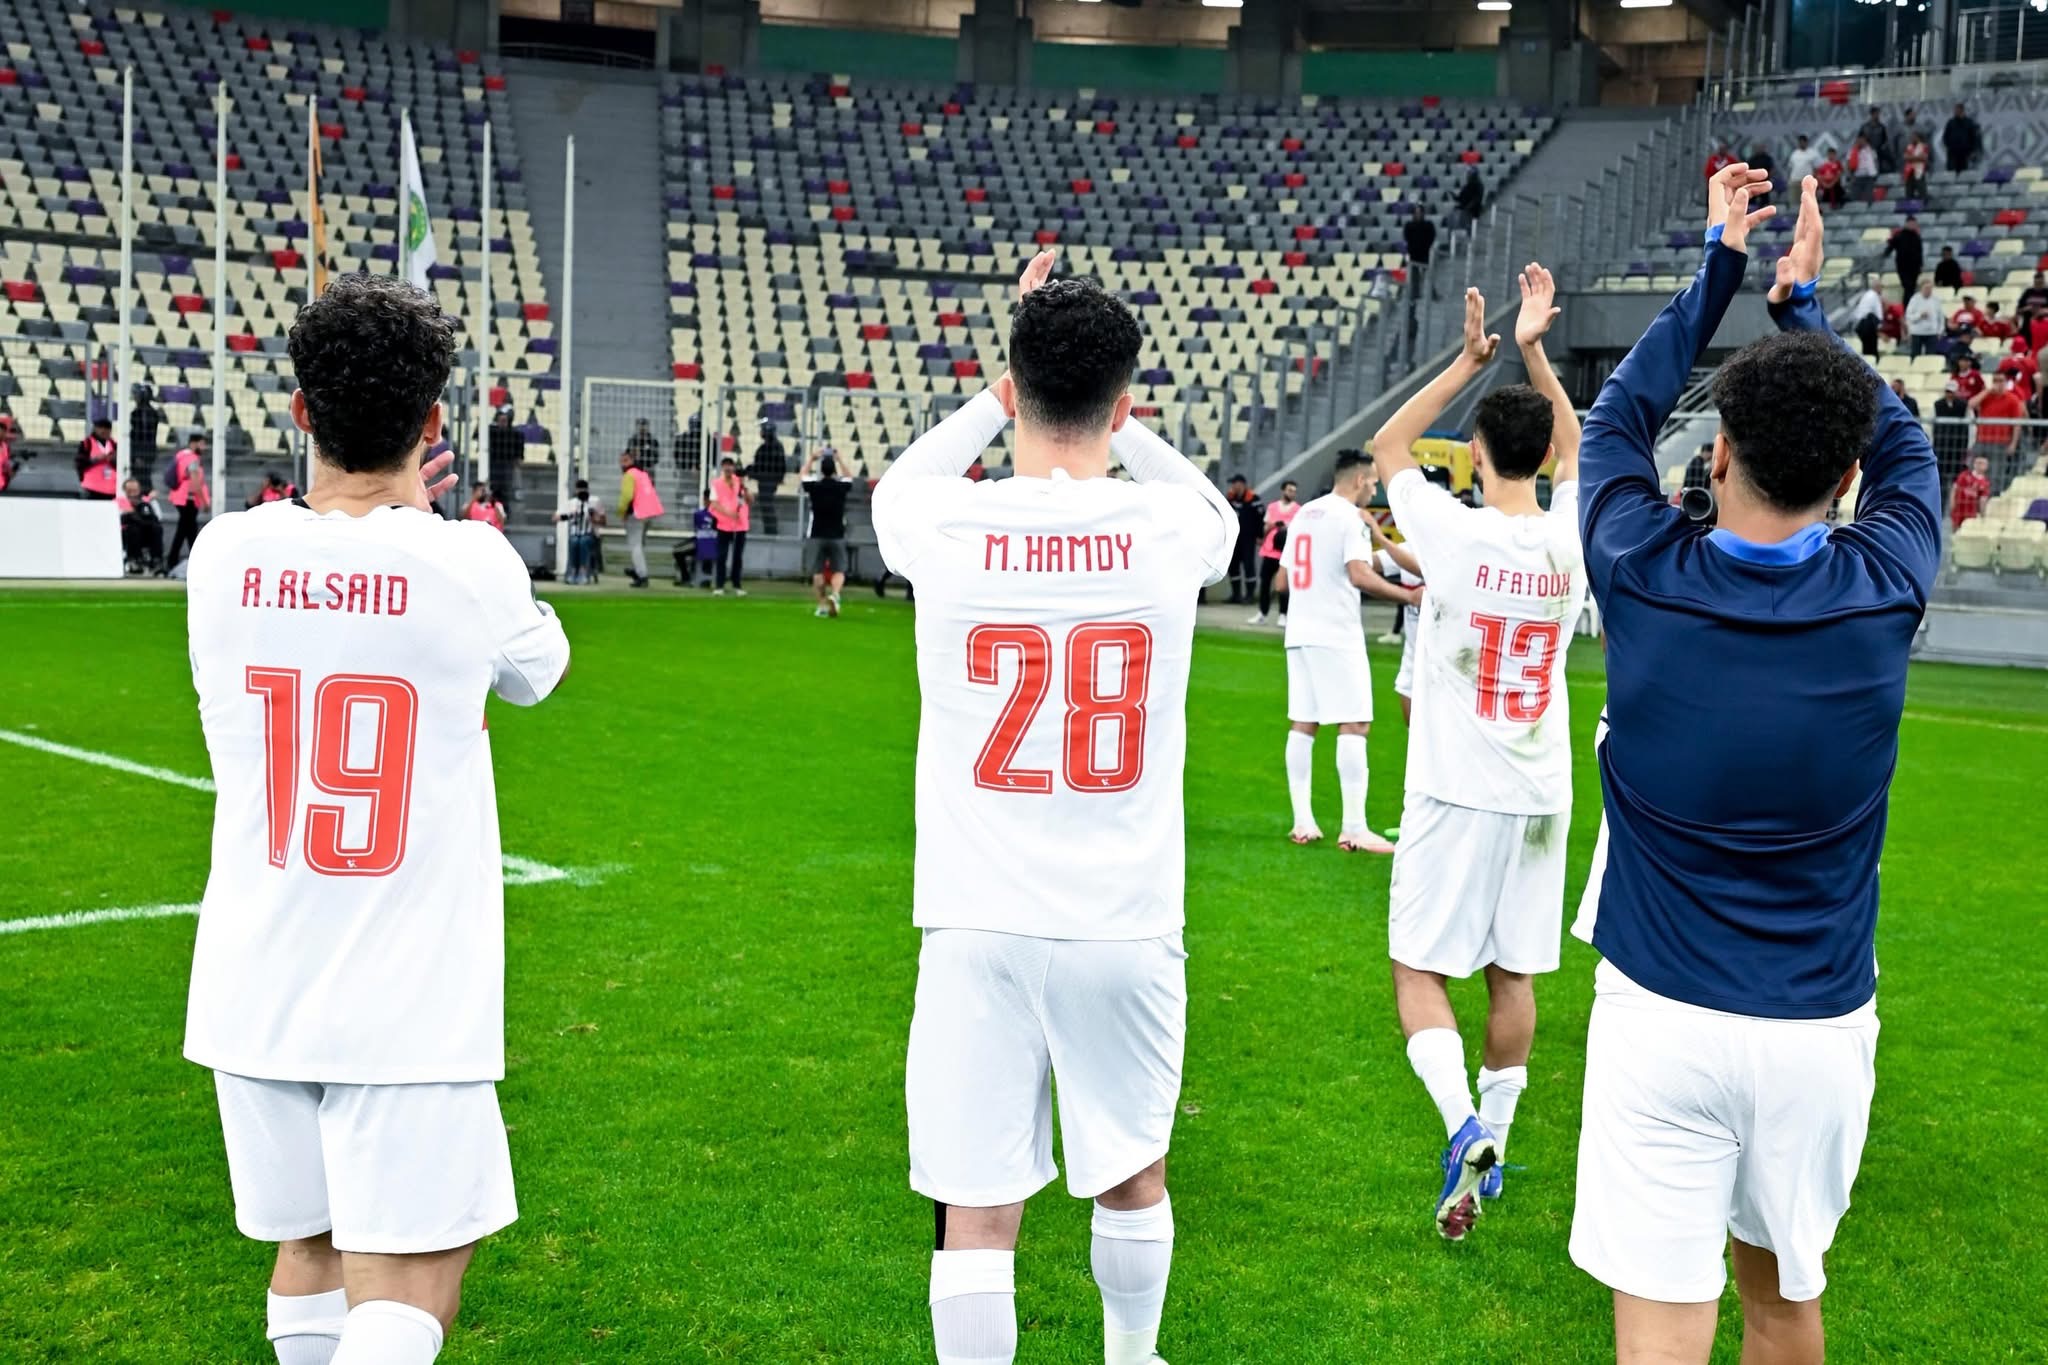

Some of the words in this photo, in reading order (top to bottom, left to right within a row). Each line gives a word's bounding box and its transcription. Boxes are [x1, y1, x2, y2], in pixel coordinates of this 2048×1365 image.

[985, 534, 1132, 571] M.HAMDY
[1293, 534, 1312, 590] 9
[242, 568, 408, 616] A.ALSAID
[1476, 565, 1568, 597] A.FATOUH
[1470, 611, 1560, 722] 13
[966, 622, 1153, 794] 28
[246, 665, 419, 877] 19
